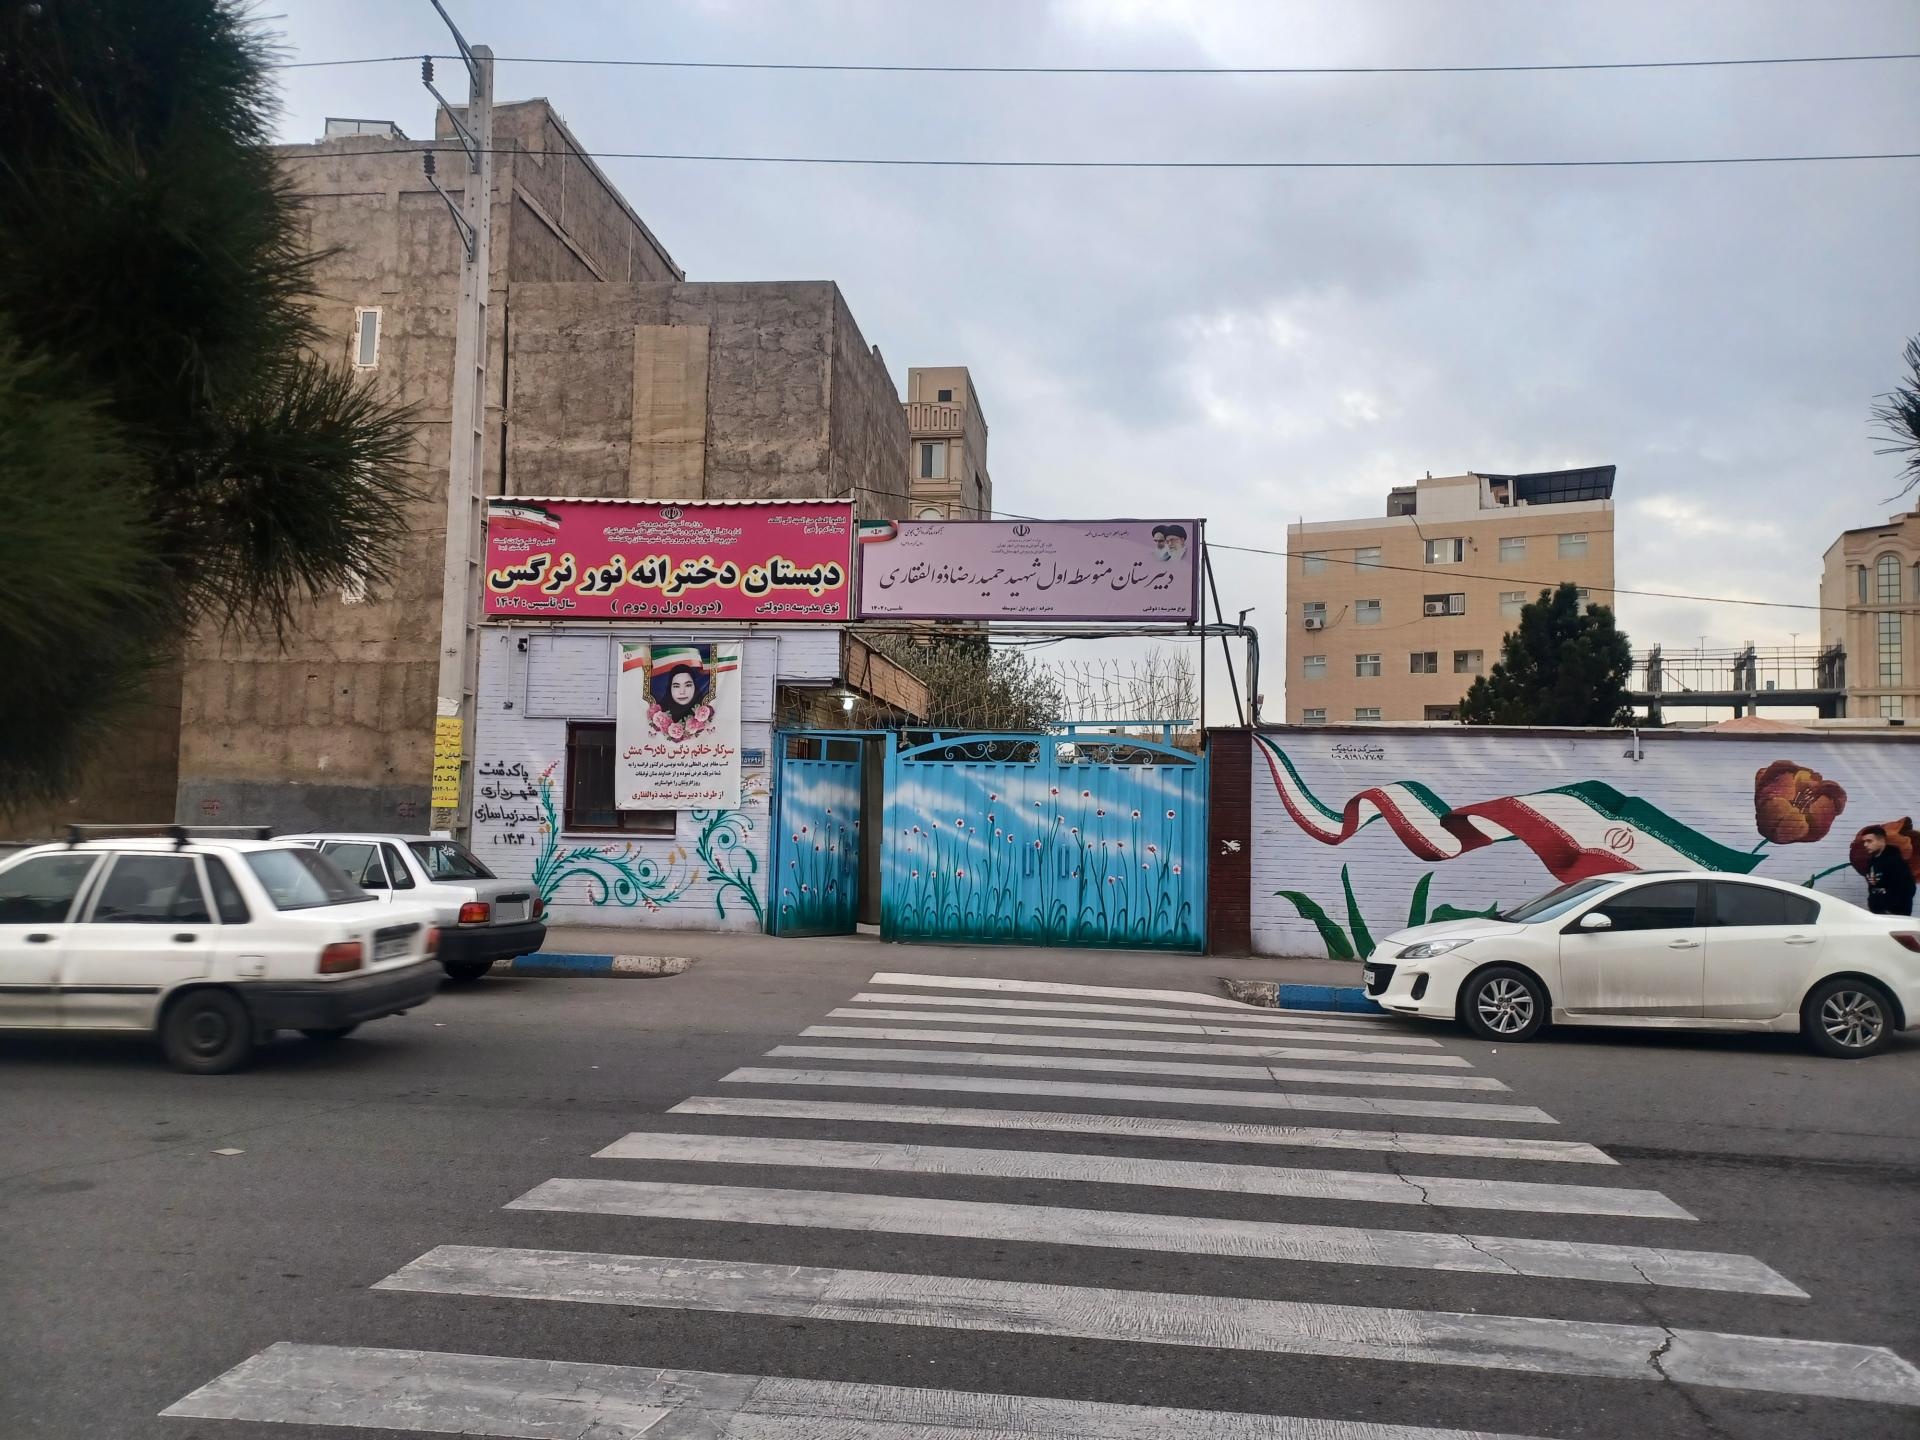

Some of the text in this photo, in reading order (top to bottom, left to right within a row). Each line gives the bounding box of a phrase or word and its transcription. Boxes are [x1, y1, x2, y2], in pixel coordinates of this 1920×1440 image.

[490, 555, 842, 595] دبستان دخترانه نور نرگس
[879, 561, 949, 590] ذوالفقاری
[1004, 557, 1041, 598] شهید
[1036, 561, 1068, 591] اول
[1111, 561, 1174, 591] دبیرستان
[558, 598, 576, 609] سال
[651, 603, 658, 613] و
[660, 600, 684, 614] اول
[756, 602, 784, 613] دولتی
[791, 602, 821, 613] مدرسه
[822, 602, 839, 615] نوع
[622, 746, 643, 760] منش
[668, 743, 690, 759] نرگس
[691, 743, 711, 759] خانم
[713, 743, 735, 759] سرکار
[478, 760, 529, 784] پاکدشت
[481, 781, 538, 801] شهرداری
[518, 805, 547, 824] واحد
